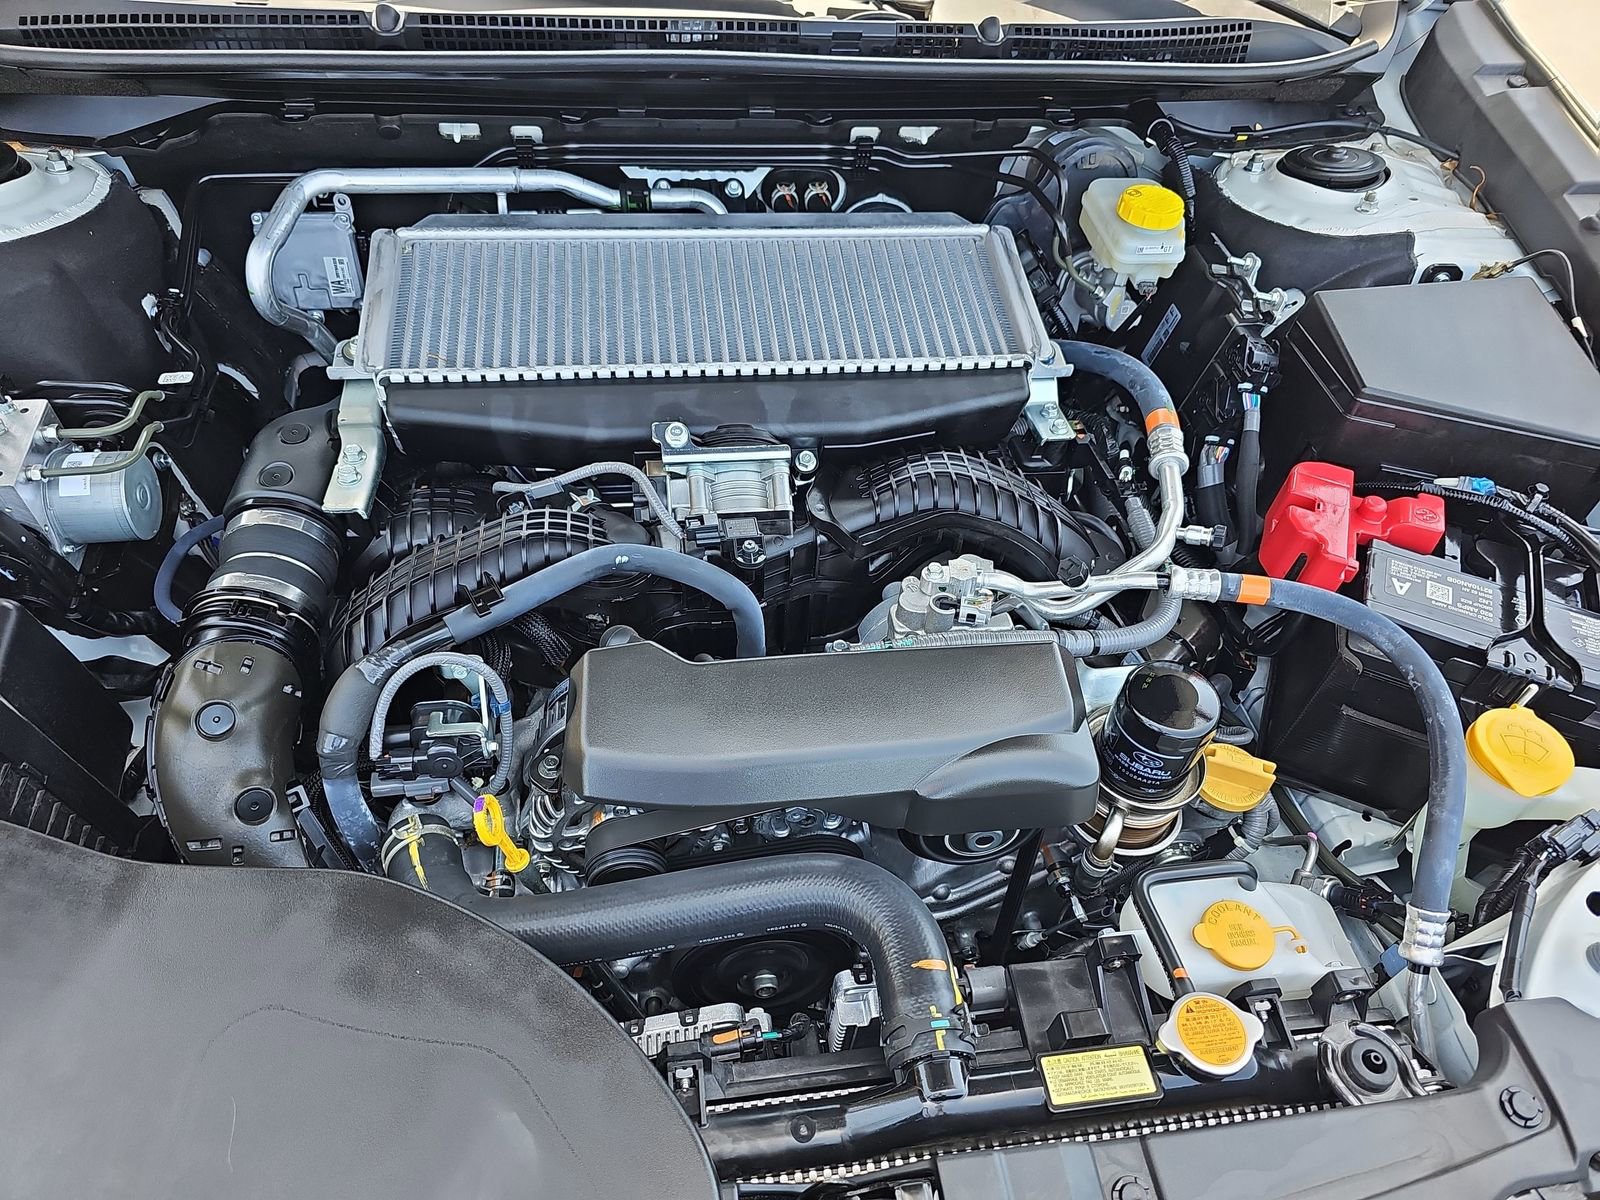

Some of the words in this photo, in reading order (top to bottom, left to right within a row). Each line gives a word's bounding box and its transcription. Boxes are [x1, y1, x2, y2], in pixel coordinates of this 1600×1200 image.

[330, 280, 346, 294] WA
[1431, 600, 1448, 609] AMPS
[1457, 602, 1479, 613] AMPS
[1448, 605, 1477, 618] CRANKING
[1480, 609, 1494, 618] 620
[1477, 614, 1494, 623] COLD
[1114, 753, 1129, 768] MADE
[1137, 770, 1172, 780] INDONESIA
[1119, 751, 1171, 776] SUBARU
[1207, 903, 1261, 925] COOLANT
